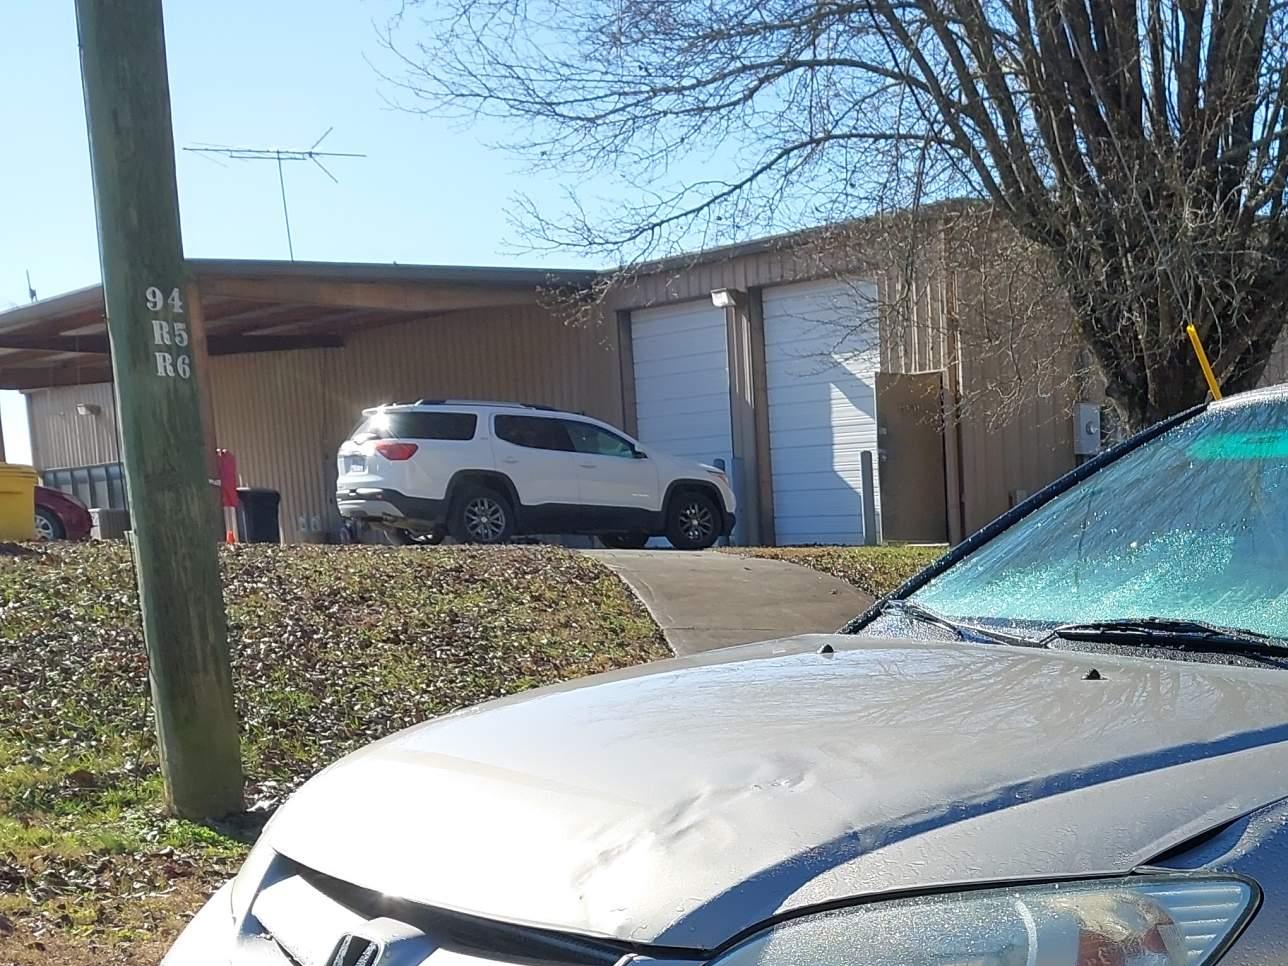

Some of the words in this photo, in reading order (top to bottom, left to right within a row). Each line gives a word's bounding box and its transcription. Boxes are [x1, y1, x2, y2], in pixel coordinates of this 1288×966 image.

[145, 286, 184, 313] 94
[151, 320, 189, 347] R5
[154, 352, 191, 379] R6
